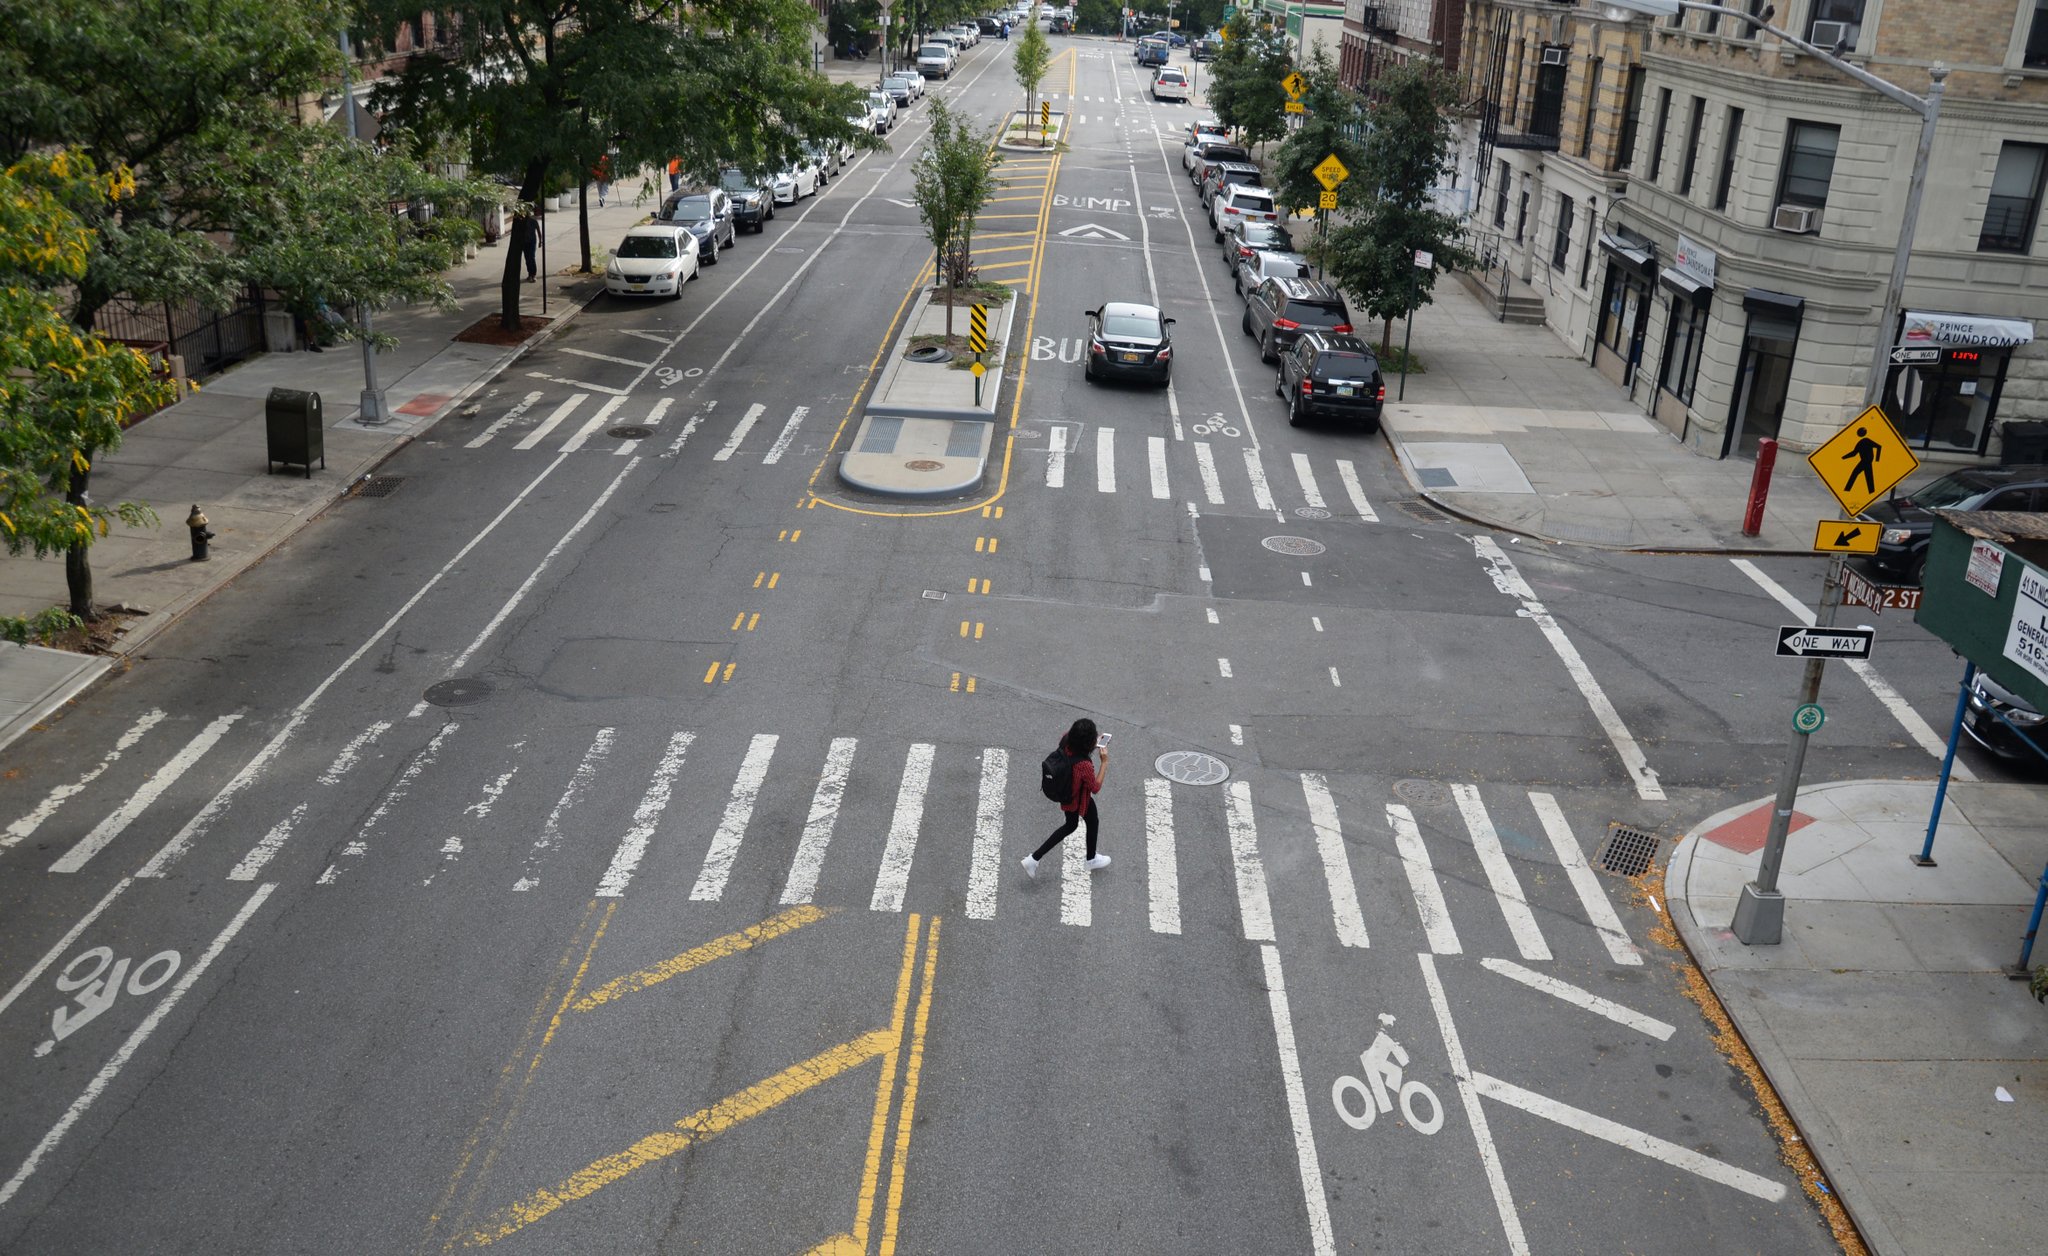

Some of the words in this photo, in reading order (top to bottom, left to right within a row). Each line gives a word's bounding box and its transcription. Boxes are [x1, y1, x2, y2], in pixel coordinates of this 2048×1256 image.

[1052, 194, 1131, 211] BUMP
[1321, 193, 1336, 203] 20
[1939, 322, 1974, 333] PRINCE
[1935, 331, 2029, 347] LAUNDROMAT
[1031, 336, 1087, 364] BU
[1895, 351, 1912, 359] ONE
[1920, 351, 1937, 360] WAY
[1840, 567, 1850, 587] ST
[1847, 574, 1875, 608] NICHOLAS
[1873, 592, 1882, 615] PL
[2030, 579, 2038, 597] ST
[1898, 590, 1920, 609] ST
[2017, 619, 2048, 649] GENERAL
[1792, 636, 1820, 649] ONE
[1832, 637, 1860, 650] WAY
